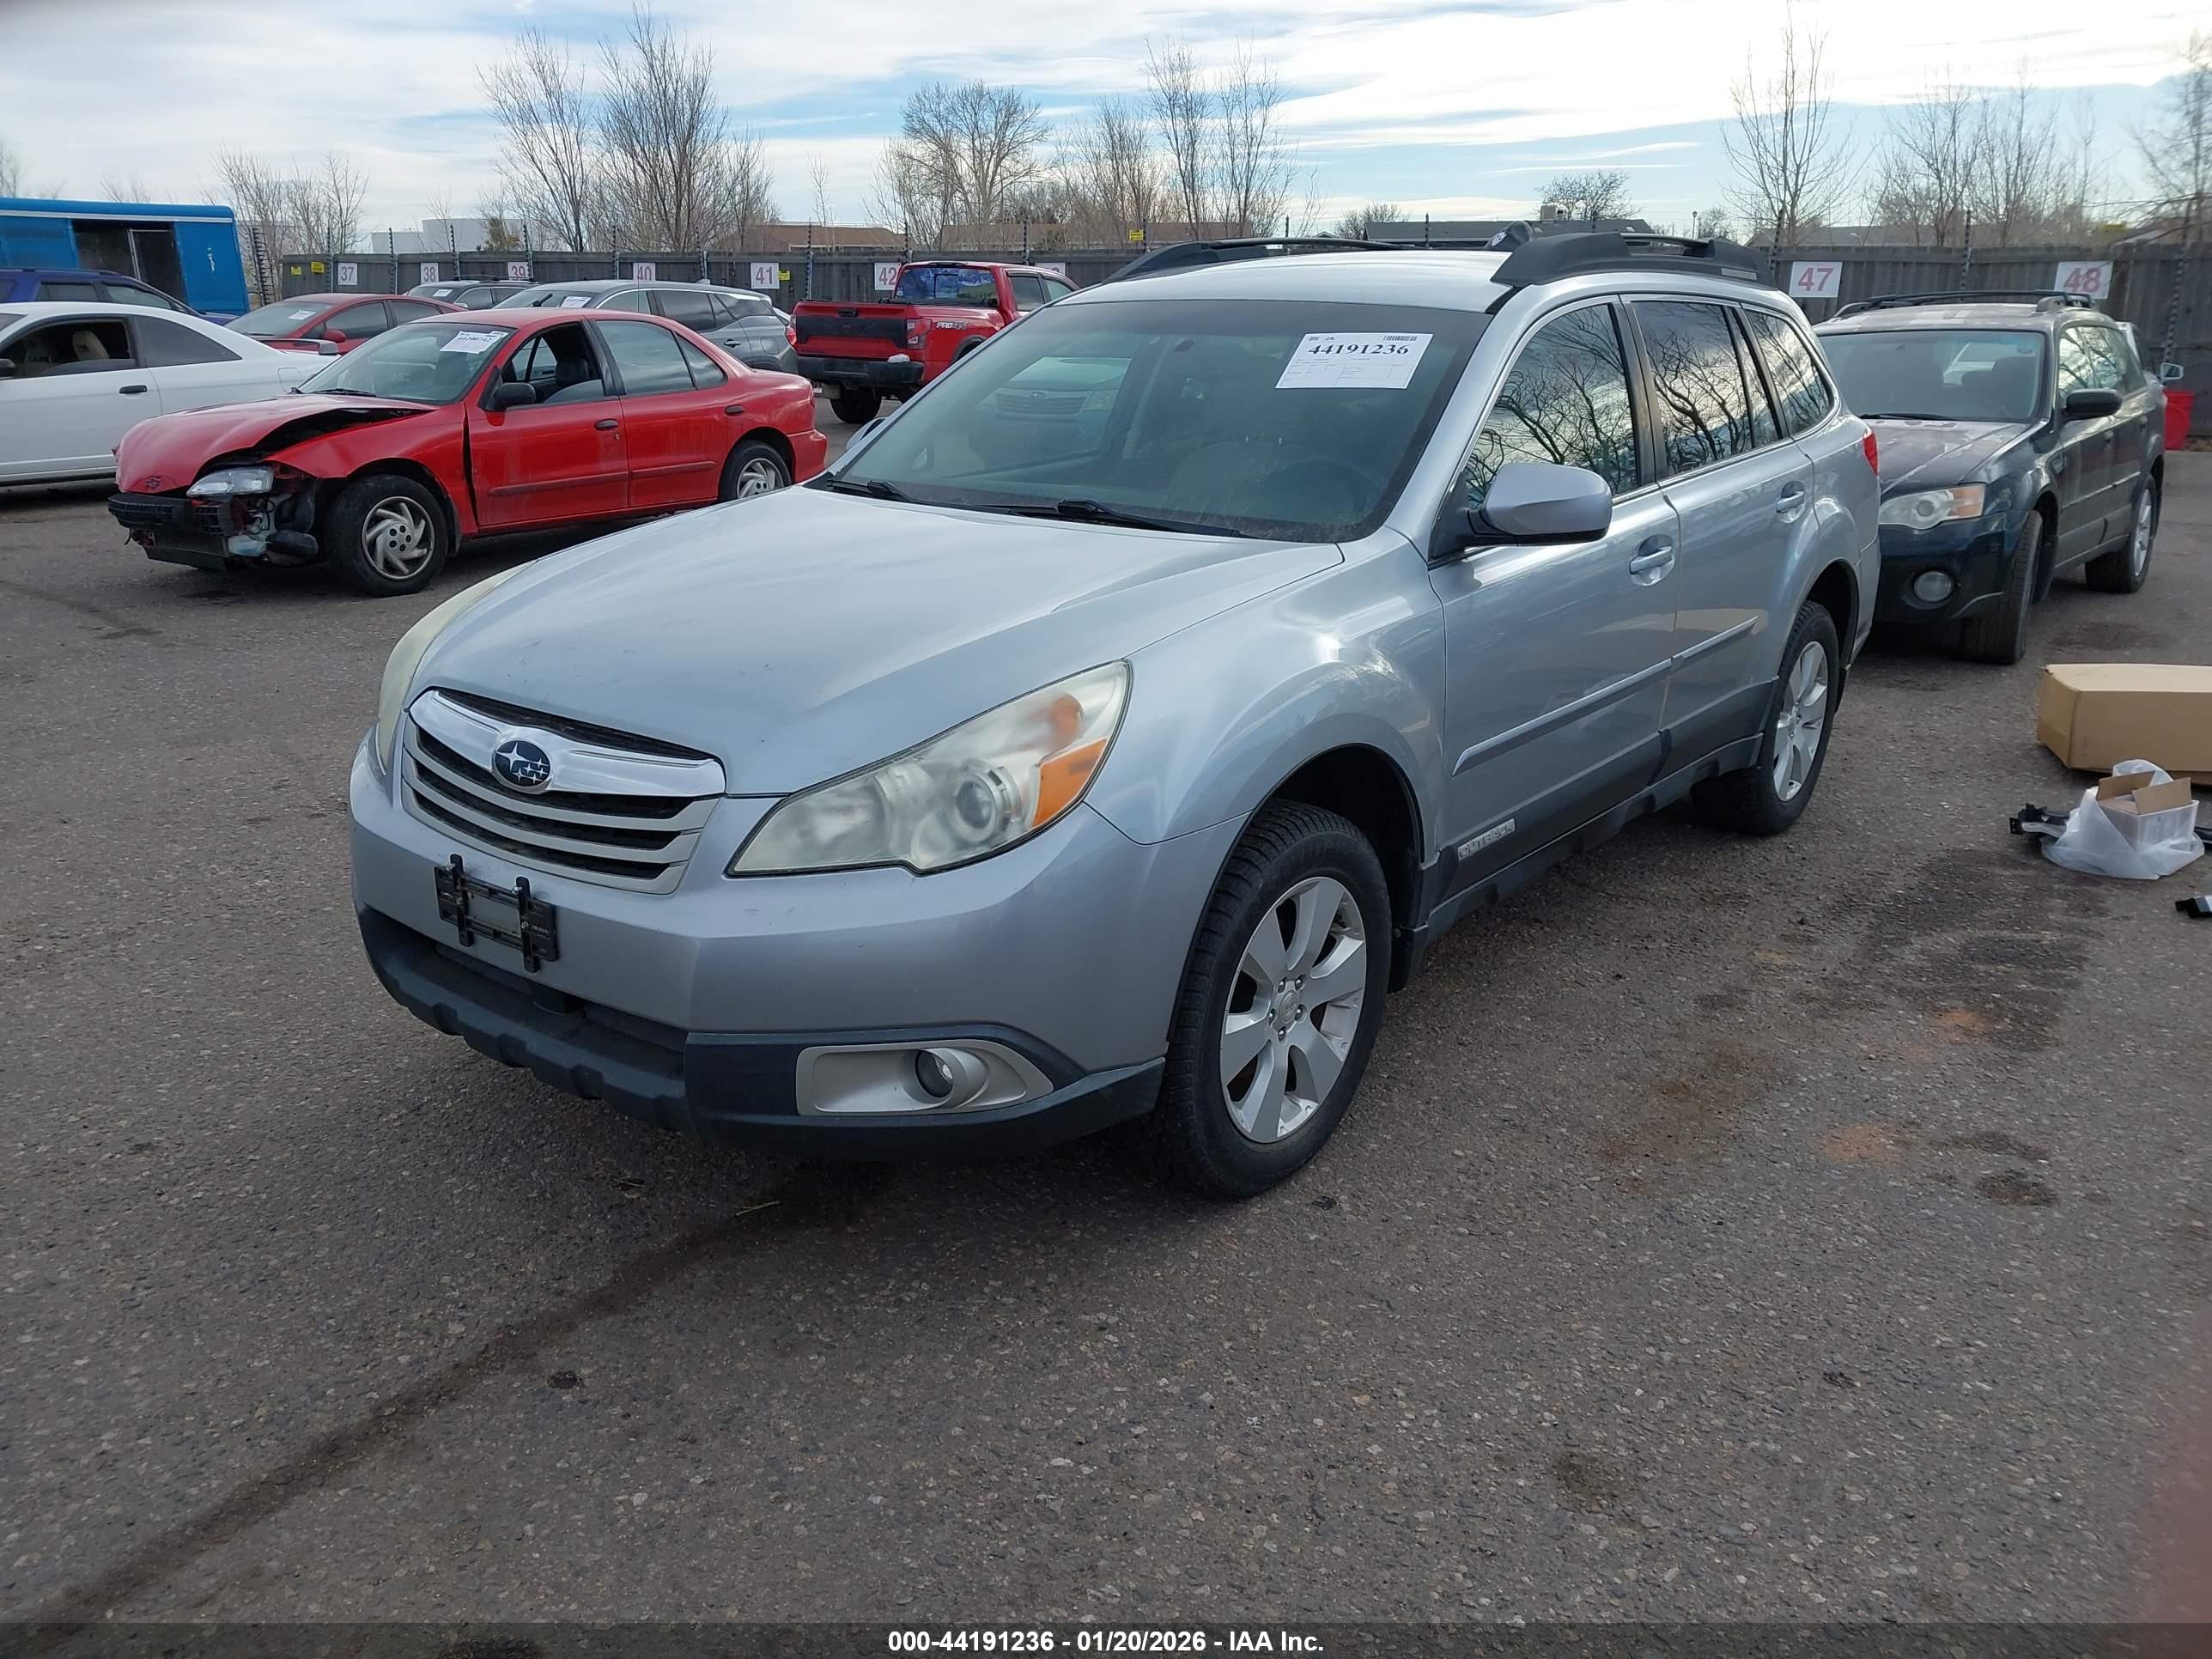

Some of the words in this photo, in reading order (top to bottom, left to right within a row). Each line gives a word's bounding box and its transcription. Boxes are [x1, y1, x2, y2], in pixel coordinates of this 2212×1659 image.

[340, 266, 355, 282] 37
[423, 266, 436, 283] 38
[637, 265, 652, 282] 40
[755, 266, 773, 285] 41
[878, 267, 897, 286] 42
[1798, 267, 1834, 291] 47
[2063, 267, 2102, 293] 48
[1308, 343, 1411, 355] 44191236
